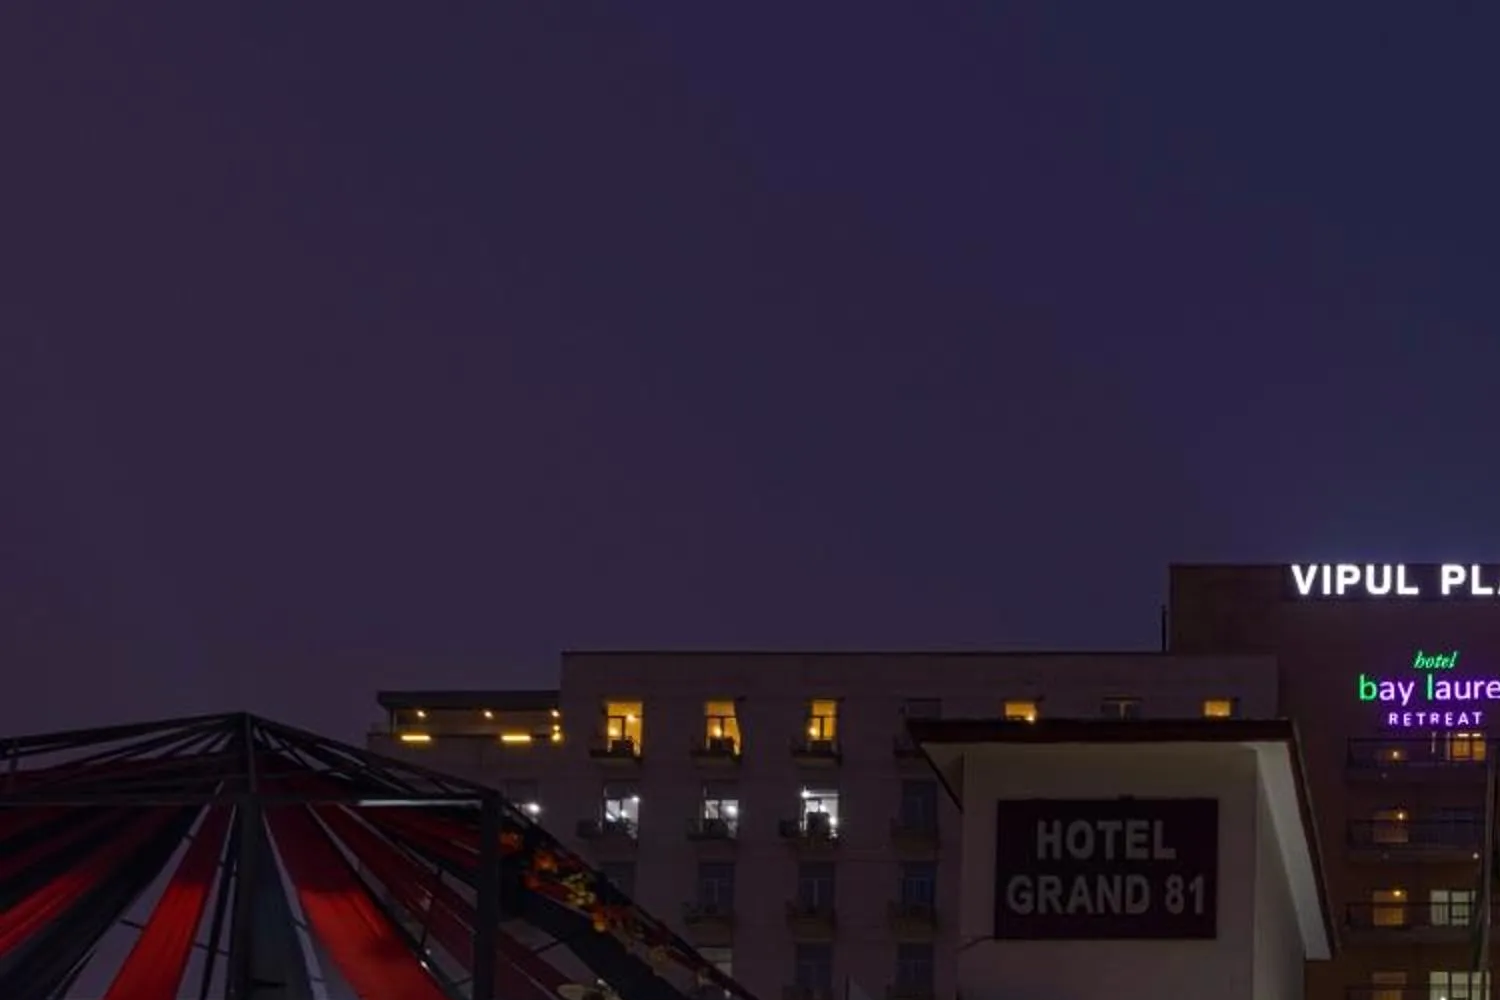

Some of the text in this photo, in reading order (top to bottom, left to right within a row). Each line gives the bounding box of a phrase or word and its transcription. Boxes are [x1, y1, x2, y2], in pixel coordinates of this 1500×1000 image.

[1291, 564, 1420, 596] VIPUL
[1413, 650, 1458, 669] hotel
[1359, 673, 1415, 706] bay
[1388, 712, 1483, 727] RETREAT
[1037, 820, 1177, 860] HOTEL
[1006, 874, 1205, 915] GRAND 81
